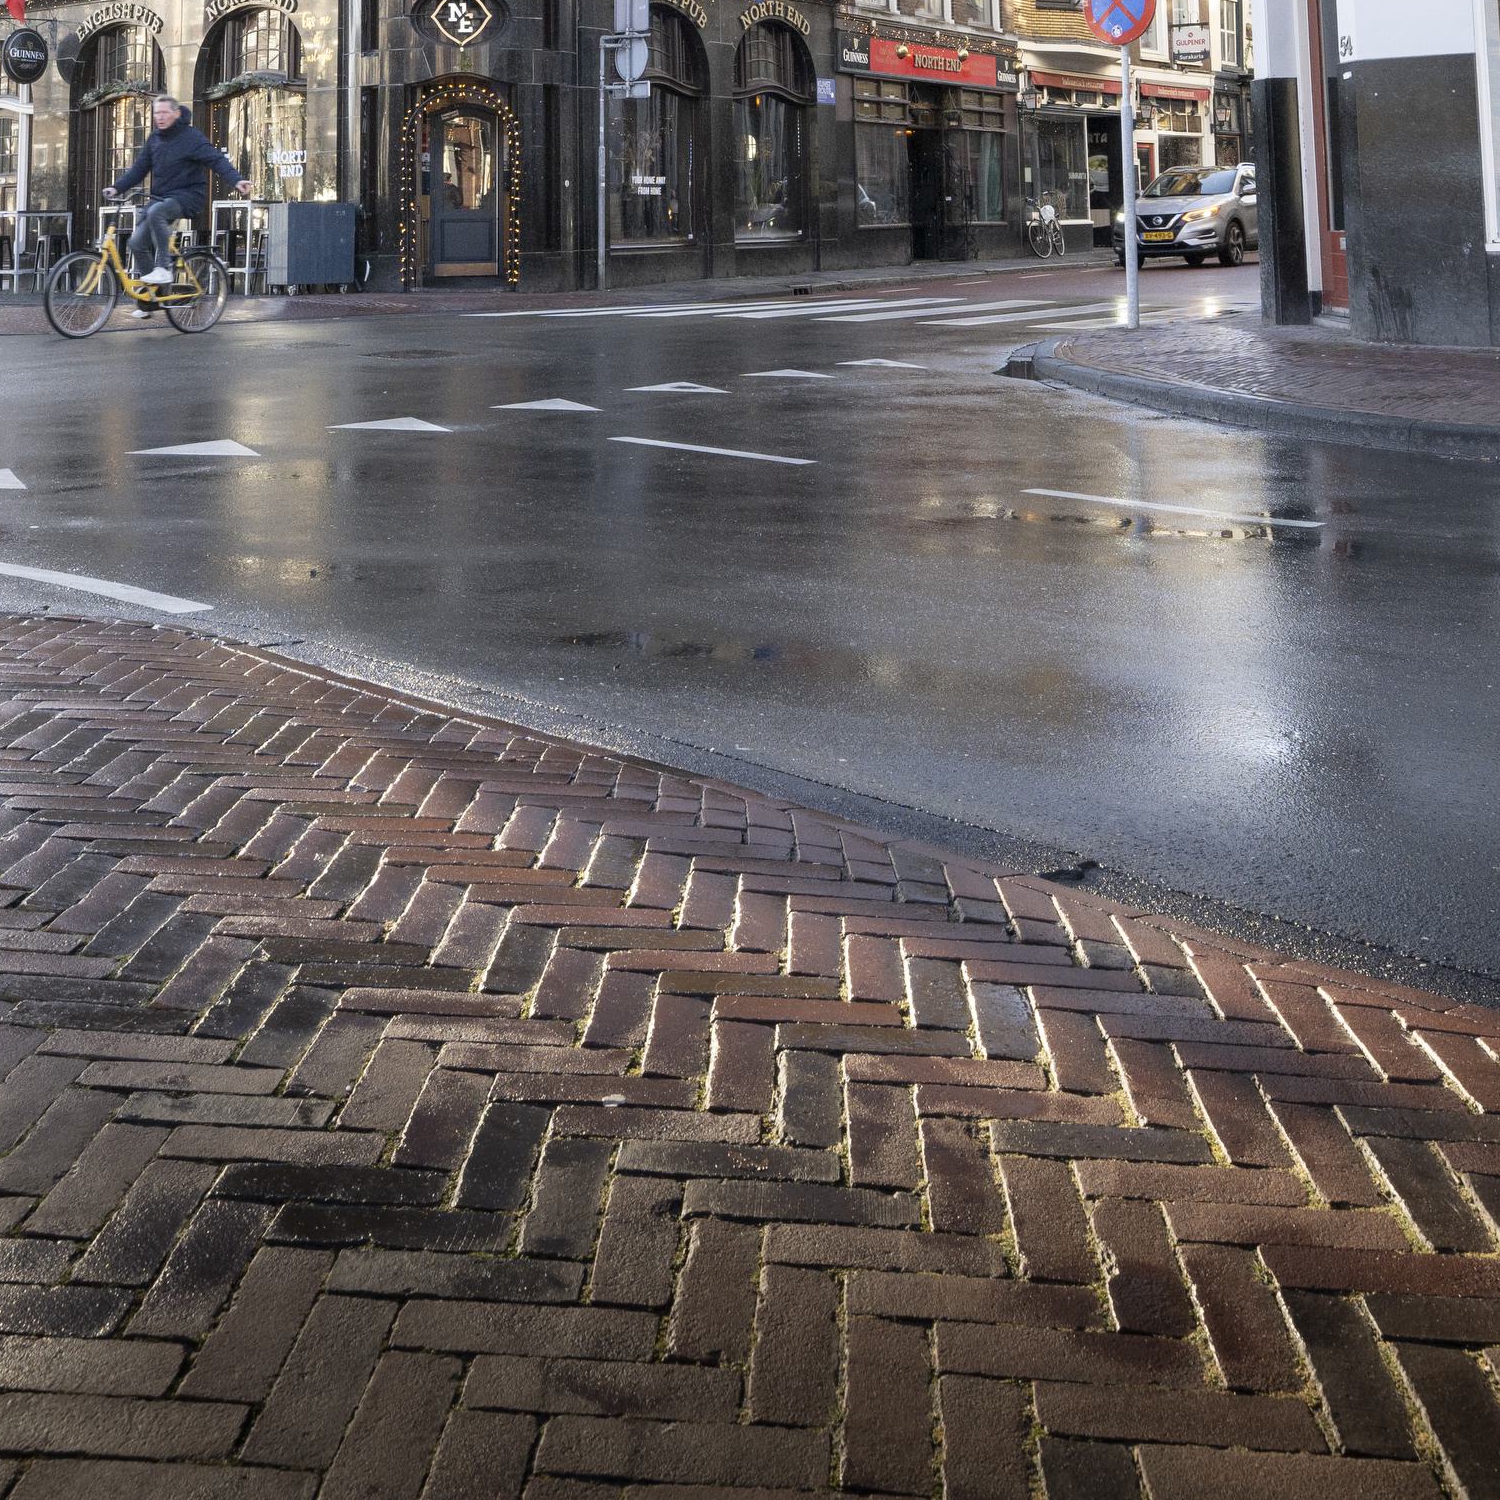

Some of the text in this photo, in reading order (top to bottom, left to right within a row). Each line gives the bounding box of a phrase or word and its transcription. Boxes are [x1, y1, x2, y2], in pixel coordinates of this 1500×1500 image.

[75, 2, 164, 43] ENGLISH PUB
[739, 0, 811, 36] NORTH END
[1175, 38, 1206, 47] GULPENER
[1339, 35, 1353, 57] 54
[9, 47, 46, 61] GUINNESS
[842, 48, 869, 65] GUINNESS
[1179, 53, 1205, 61] Surakarta
[913, 54, 946, 71] NORTH
[945, 57, 963, 73] END
[997, 71, 1017, 84] GUINNESS
[280, 164, 304, 177] END
